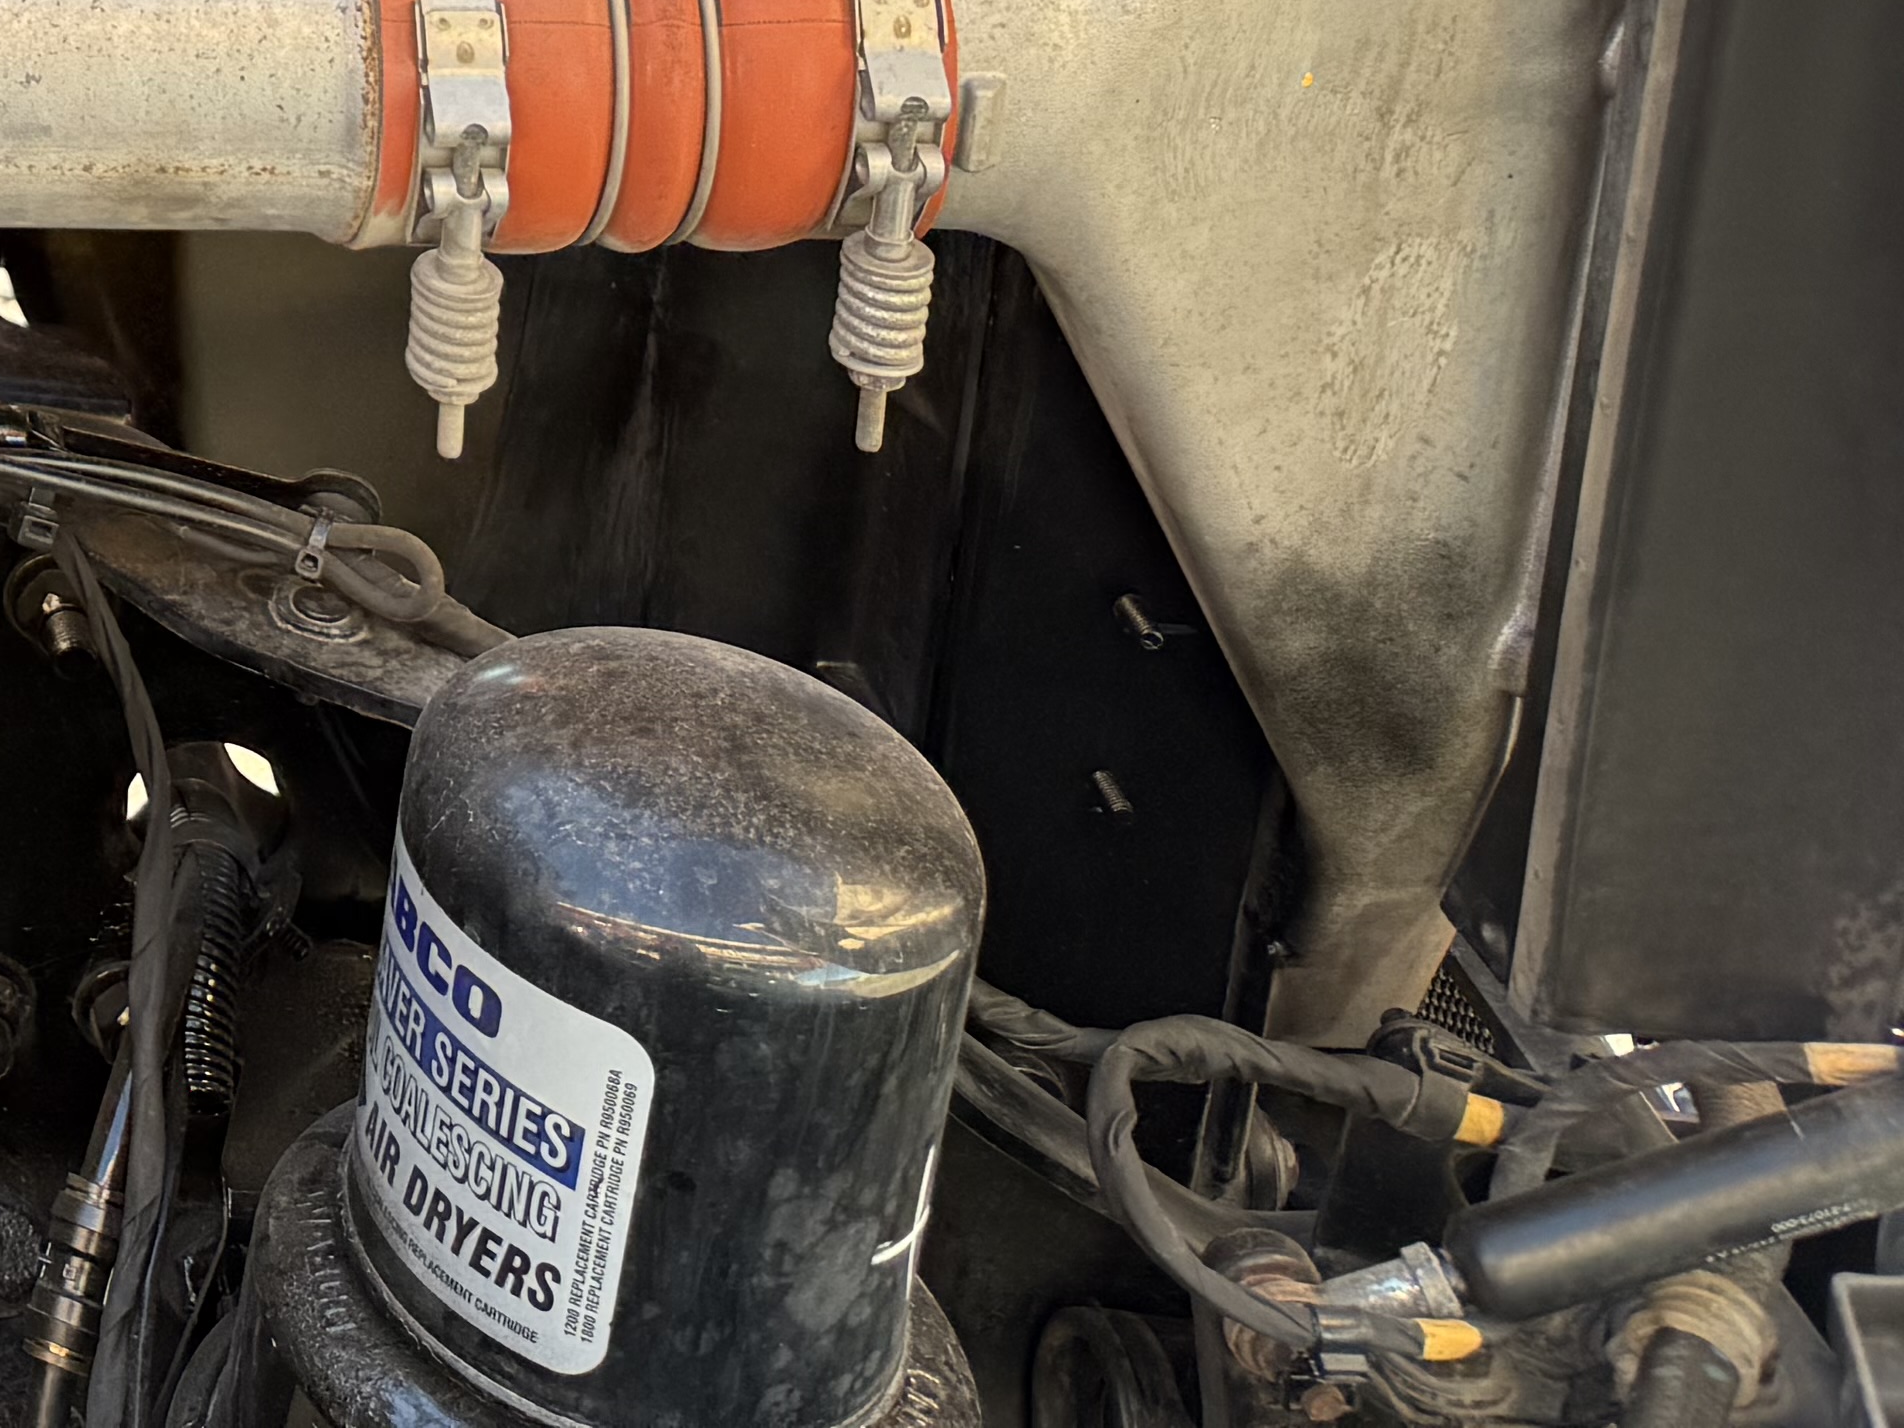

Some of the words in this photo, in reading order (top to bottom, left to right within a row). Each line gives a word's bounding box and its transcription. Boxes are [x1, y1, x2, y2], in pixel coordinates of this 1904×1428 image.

[431, 1032, 571, 1170] SERIES
[617, 1082, 638, 1135] R950069
[379, 1036, 562, 1243] COALESCING
[596, 1130, 611, 1150] PN
[614, 1137, 628, 1157] PN
[364, 1100, 400, 1191] AIR
[403, 1163, 561, 1312] DRYERS
[584, 1150, 606, 1220] CARTRIDGE
[601, 1158, 623, 1226] CARTRIDGE
[407, 1238, 474, 1304] REPLACEMENT
[475, 1297, 539, 1344] CARTRIDGE
[568, 1222, 594, 1307] REPLACEMENT
[585, 1228, 612, 1315] REPLACEMENT
[564, 1307, 580, 1337] 1200
[581, 1314, 597, 1344] 1800
